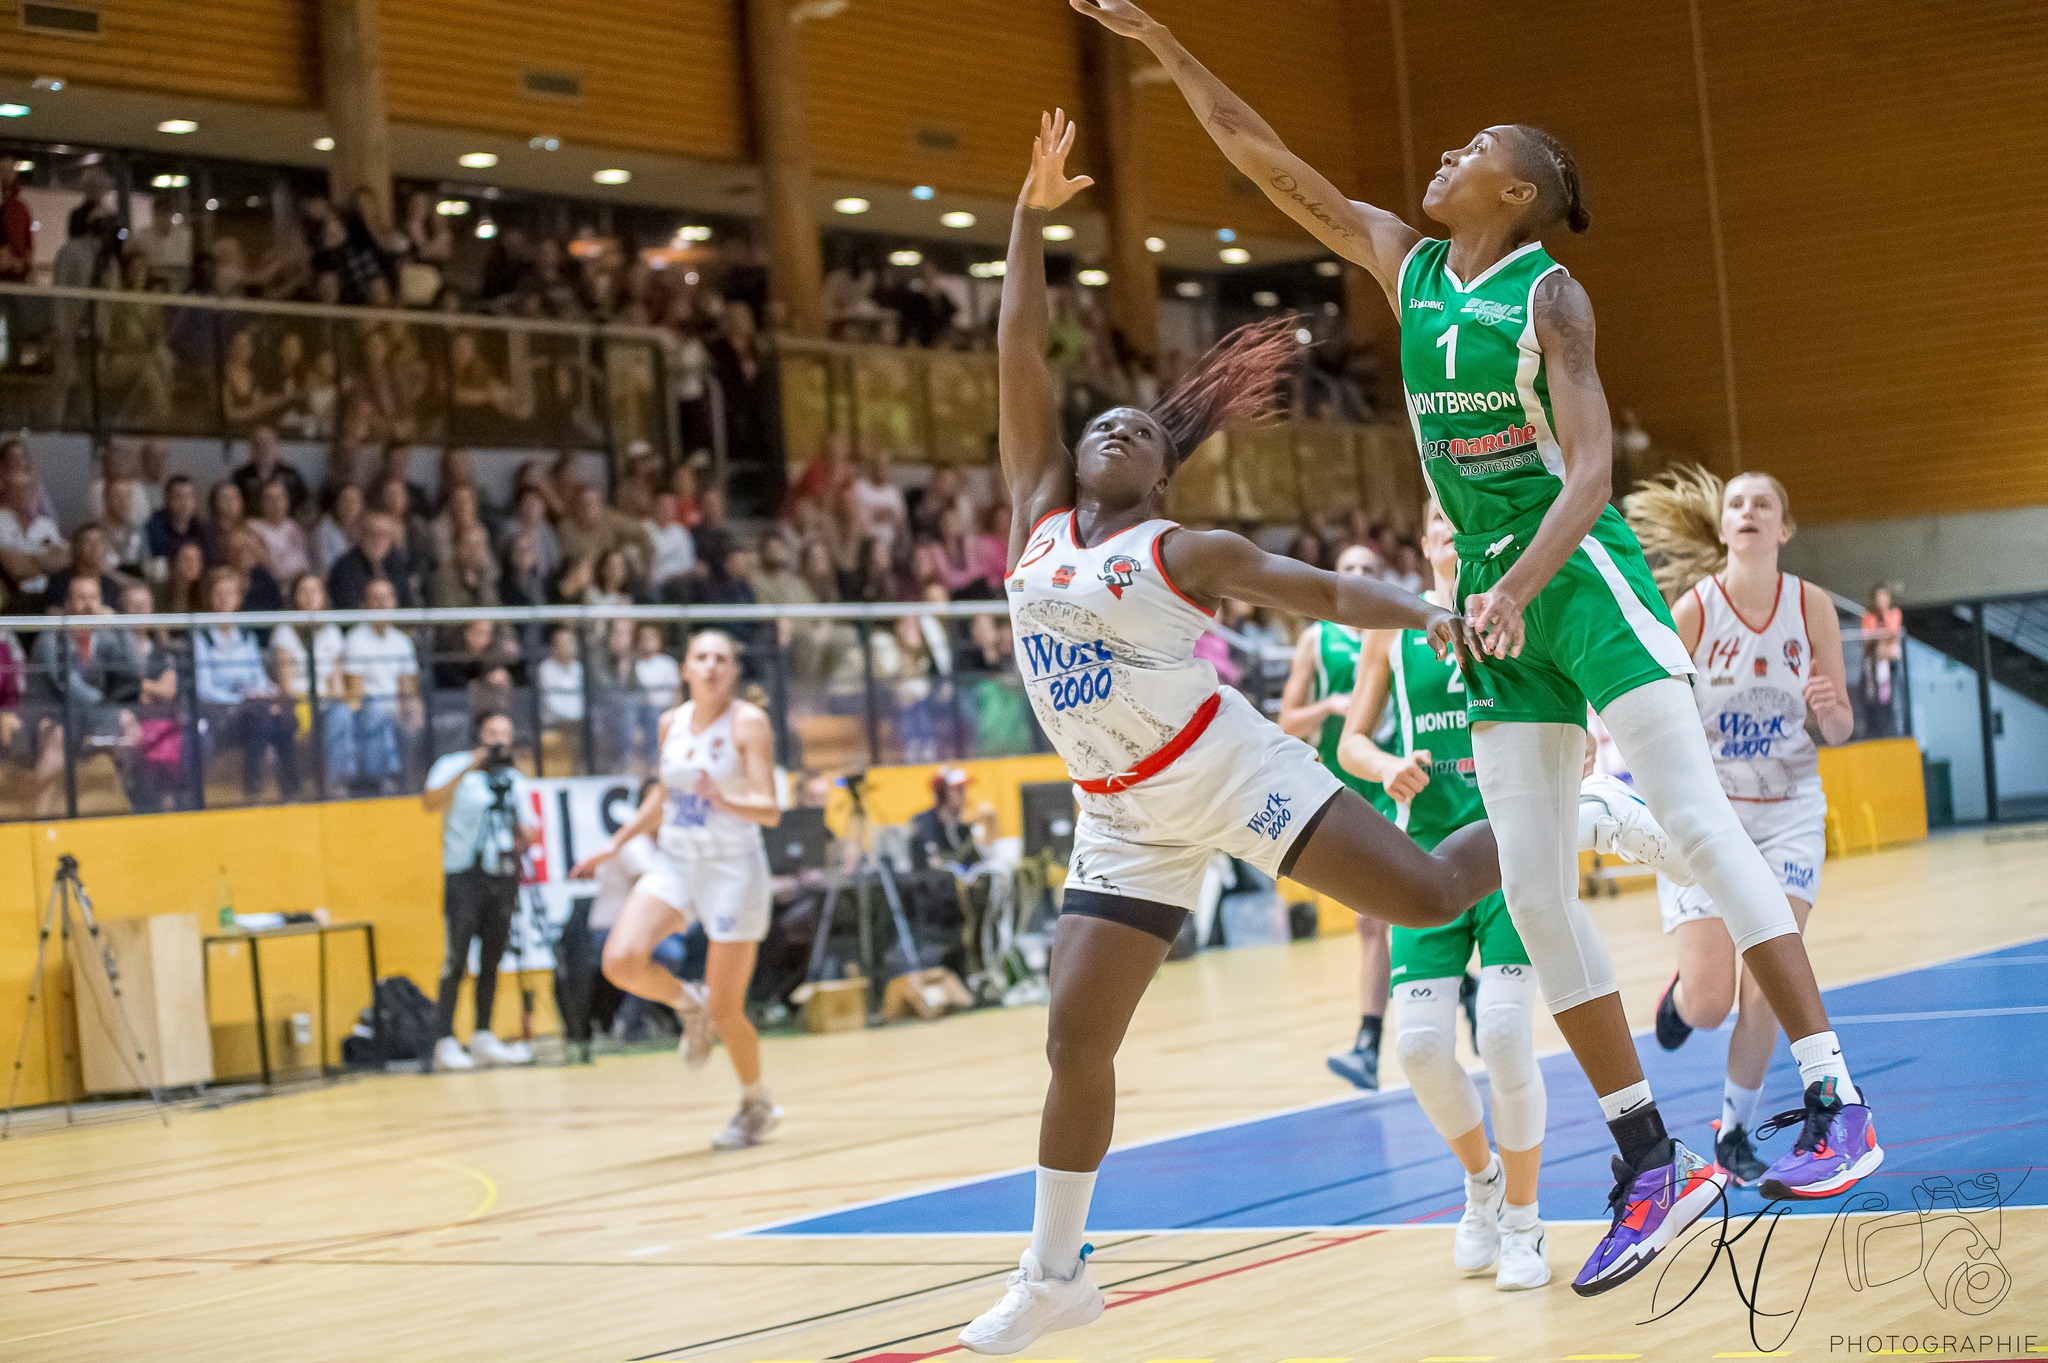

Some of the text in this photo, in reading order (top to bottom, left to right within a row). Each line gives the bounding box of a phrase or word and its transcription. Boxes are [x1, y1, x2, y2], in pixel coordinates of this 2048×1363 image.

[1409, 298, 1445, 311] SPALDING
[1436, 324, 1459, 379] 1
[1411, 391, 1516, 415] MONTBRISON
[1460, 451, 1541, 476] MONTBRISON
[1708, 636, 1740, 670] 14
[1049, 667, 1113, 712] 2000
[1415, 709, 1469, 734] MONTB
[1247, 792, 1291, 835] Work
[1268, 808, 1291, 840] 2000
